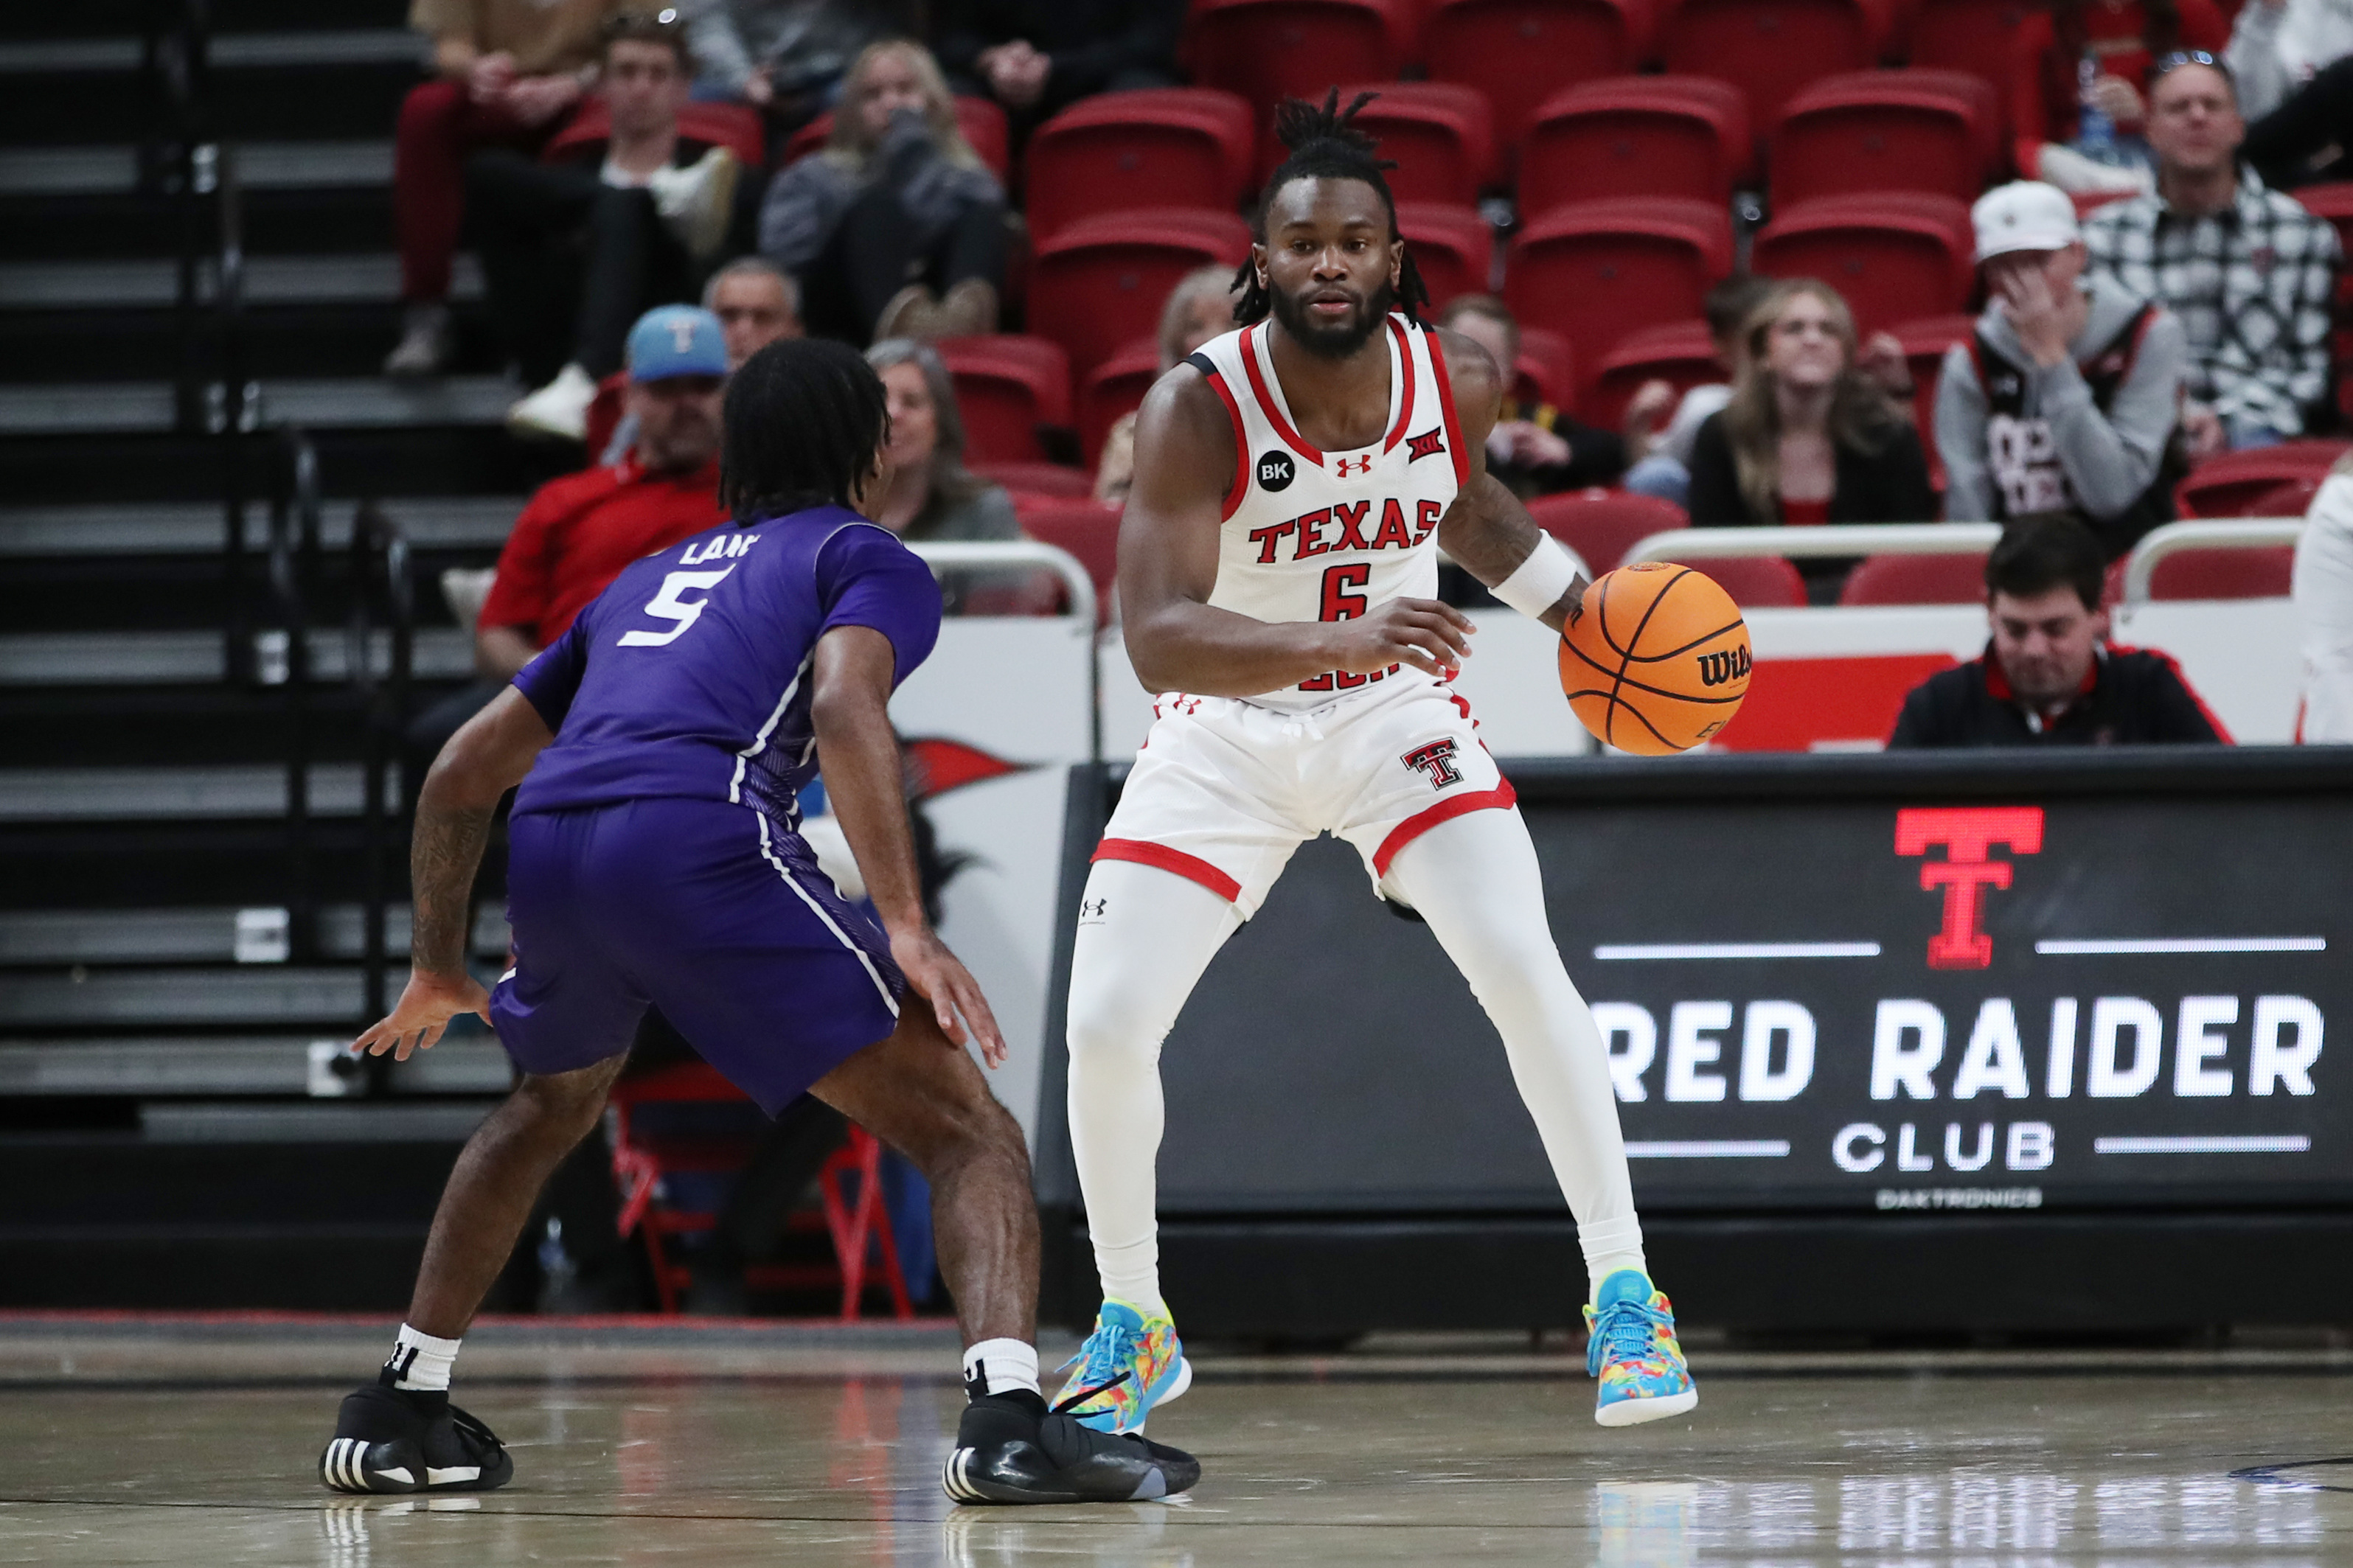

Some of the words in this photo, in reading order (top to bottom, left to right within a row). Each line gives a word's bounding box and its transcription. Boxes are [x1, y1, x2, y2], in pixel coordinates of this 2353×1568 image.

[1262, 462, 1290, 480] BK
[1248, 498, 1442, 564] TEXAS
[616, 562, 737, 647] 5
[1318, 562, 1371, 622] 6
[1590, 1000, 1818, 1102] RED
[1870, 995, 2325, 1100] RAIDER
[1832, 1121, 2055, 1172] CLUB
